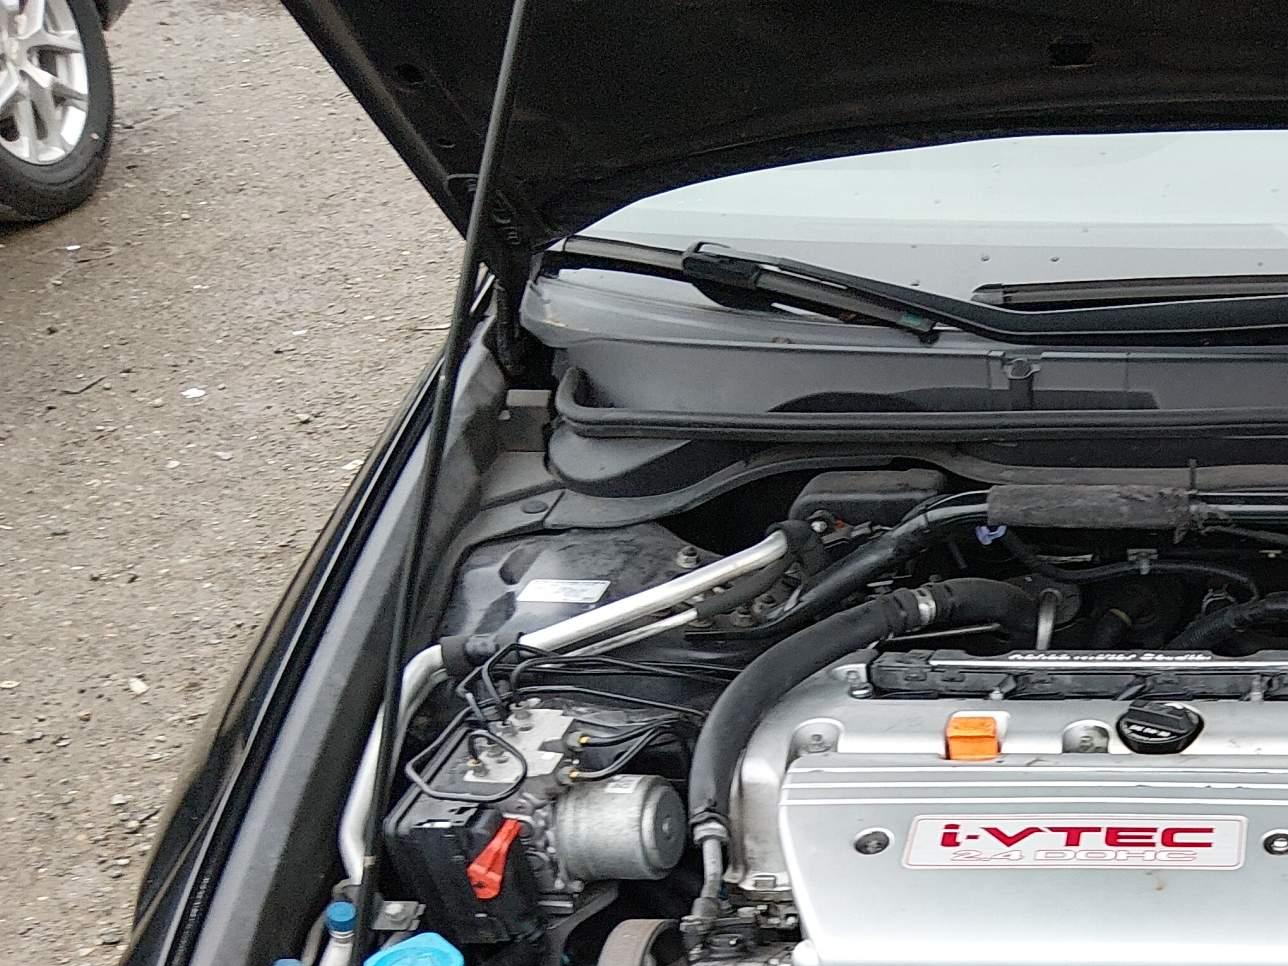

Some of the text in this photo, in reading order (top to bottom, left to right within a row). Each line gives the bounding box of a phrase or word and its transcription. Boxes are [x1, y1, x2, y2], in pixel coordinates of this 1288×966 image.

[940, 823, 1215, 848] i-VTEC
[951, 849, 1198, 862] 2.4 DOHC
